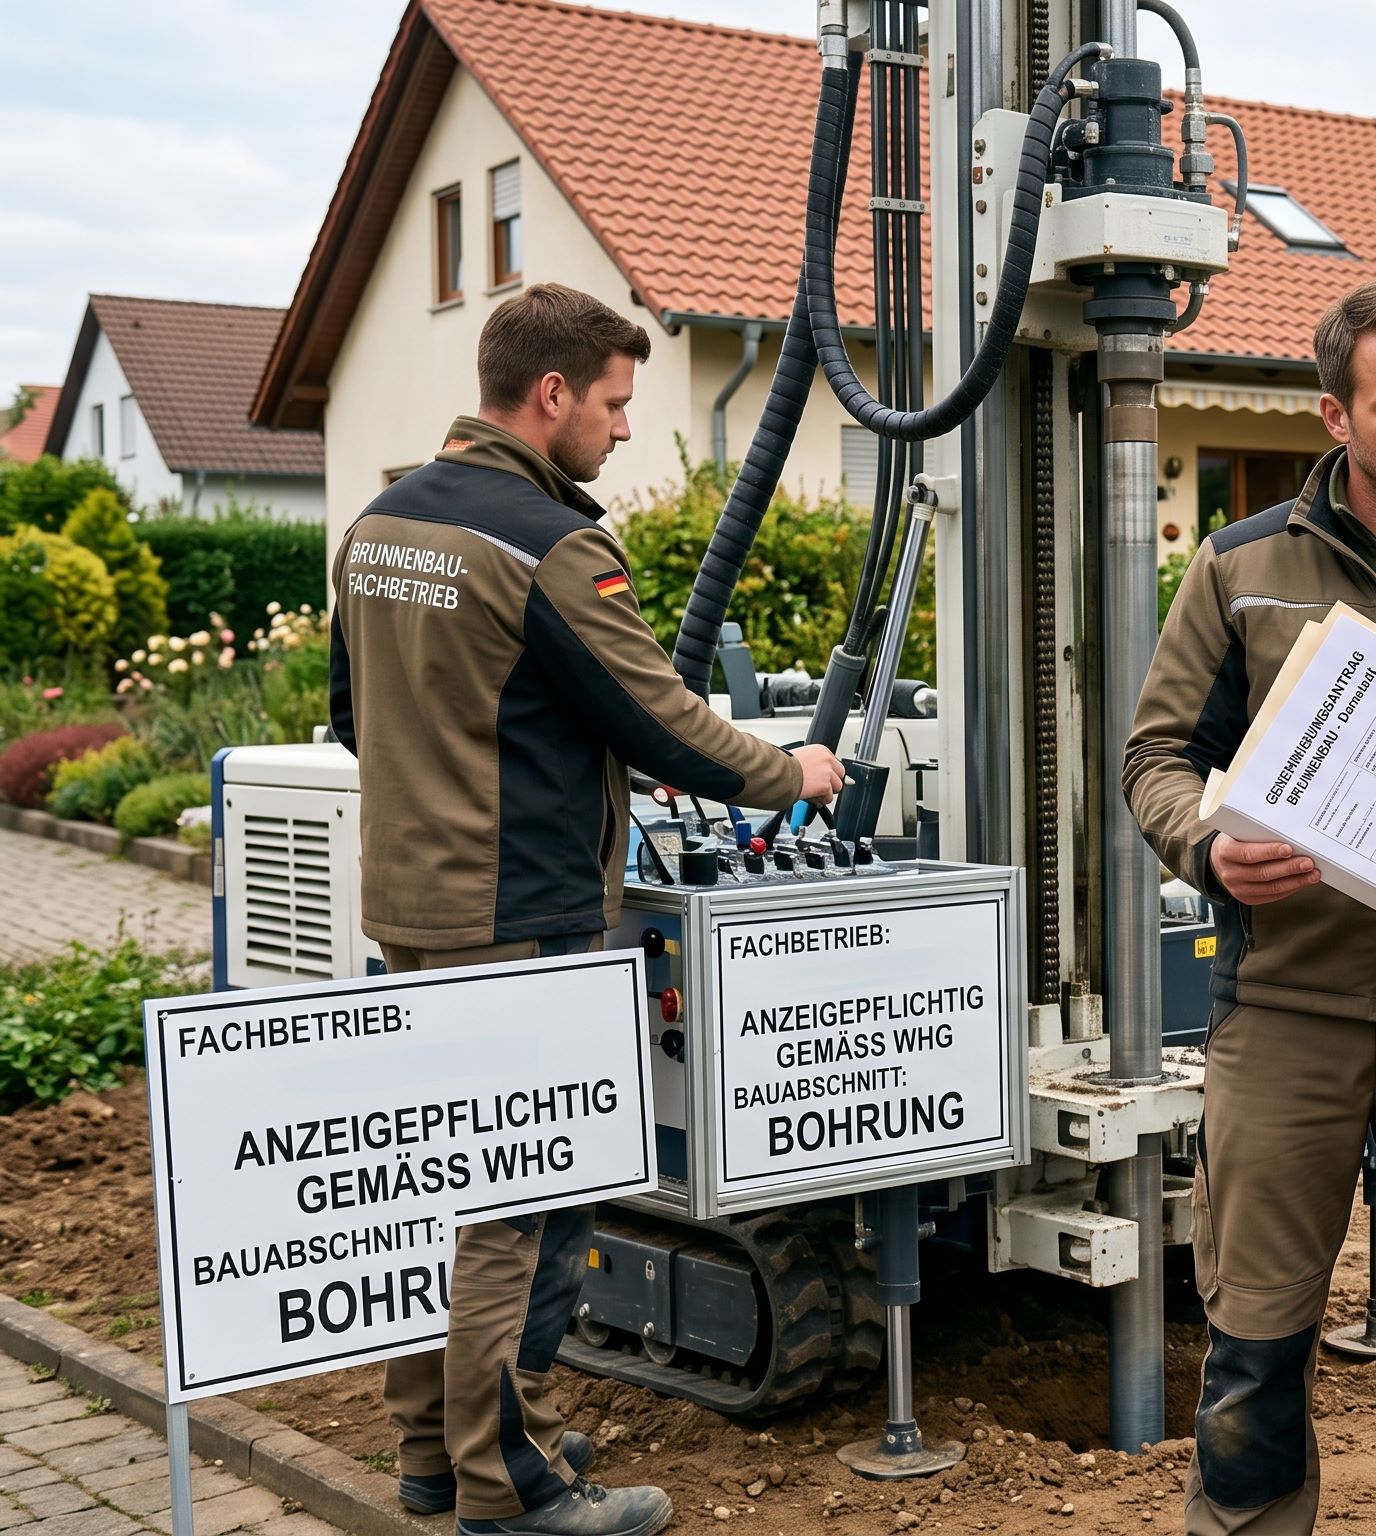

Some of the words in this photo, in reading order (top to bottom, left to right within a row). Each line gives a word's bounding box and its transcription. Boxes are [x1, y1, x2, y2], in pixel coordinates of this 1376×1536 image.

[349, 541, 469, 578] BRUNNENBAU-
[348, 573, 459, 610] FACHBETRIEB
[729, 924, 892, 960] FACHBETRIEB:
[178, 1004, 412, 1058] FACHBETRIEB:
[740, 985, 984, 1038] ANZEIGEPFLICHTIG
[776, 1030, 887, 1069] GEMÄSS
[892, 1023, 953, 1054] WHG
[734, 1066, 908, 1110] BAUABSCHNITT:
[234, 1078, 618, 1171] ANZEIGEPFLICHTIG
[768, 1091, 964, 1157] BOHRUNG
[297, 1150, 471, 1214] GEMÄSS
[481, 1135, 574, 1184] WHG
[193, 1218, 443, 1286] BAUABSCHNITT:
